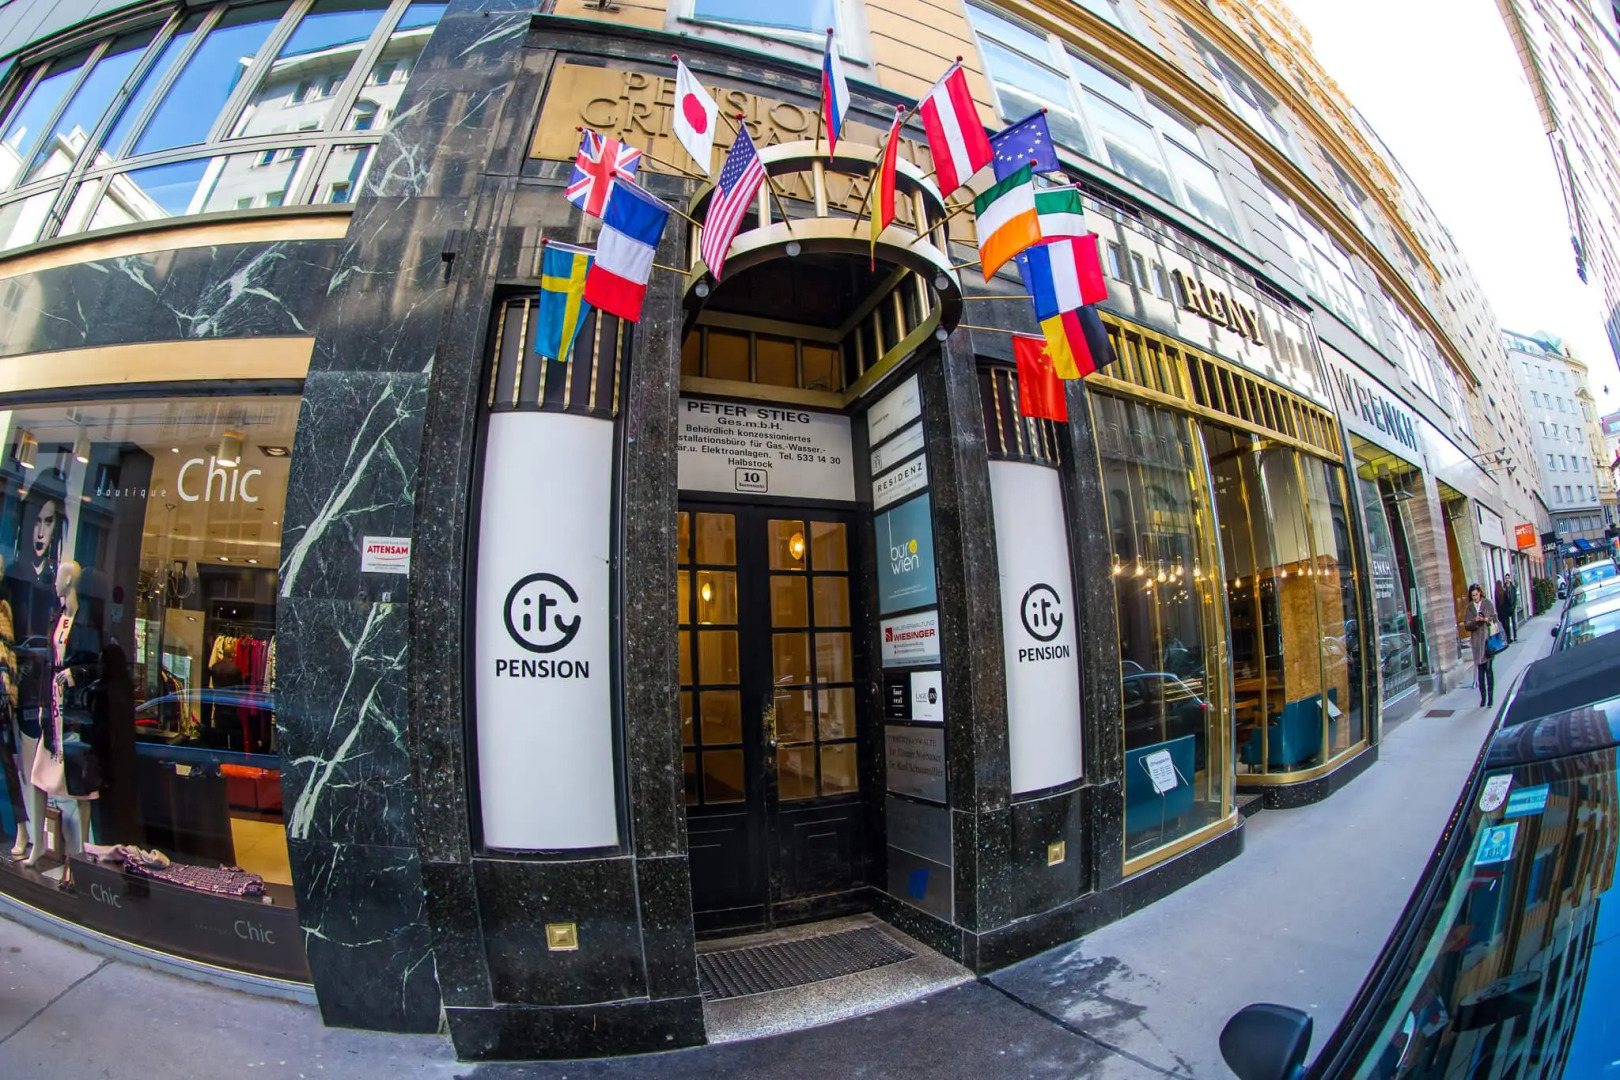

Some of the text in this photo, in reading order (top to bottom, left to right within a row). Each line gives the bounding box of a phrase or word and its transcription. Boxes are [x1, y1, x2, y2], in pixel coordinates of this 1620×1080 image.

[1172, 268, 1264, 346] RENY
[687, 401, 810, 424] PETER STIEG
[1330, 363, 1418, 452] WRENKH
[686, 424, 811, 443] Behördlich konzessioniertes
[717, 417, 782, 430] Ges.m.b.H.
[750, 440, 763, 448] für
[701, 445, 772, 459] Elektroanlagen.
[779, 451, 794, 461] Tel.
[797, 453, 814, 462] 533
[818, 455, 826, 463] 14
[830, 456, 841, 465] 30
[728, 457, 773, 469] Halbstock
[96, 455, 262, 503] boutique Chic
[743, 472, 760, 483] 10
[877, 462, 923, 493] RESIDENZ
[367, 545, 409, 554] ATTENSAM
[891, 554, 919, 576] wien
[893, 628, 935, 642] WIESINGER
[1018, 645, 1070, 663] PENSION
[495, 658, 590, 679] PENSION
[90, 883, 122, 909] Chic
[234, 920, 276, 945] Chic
